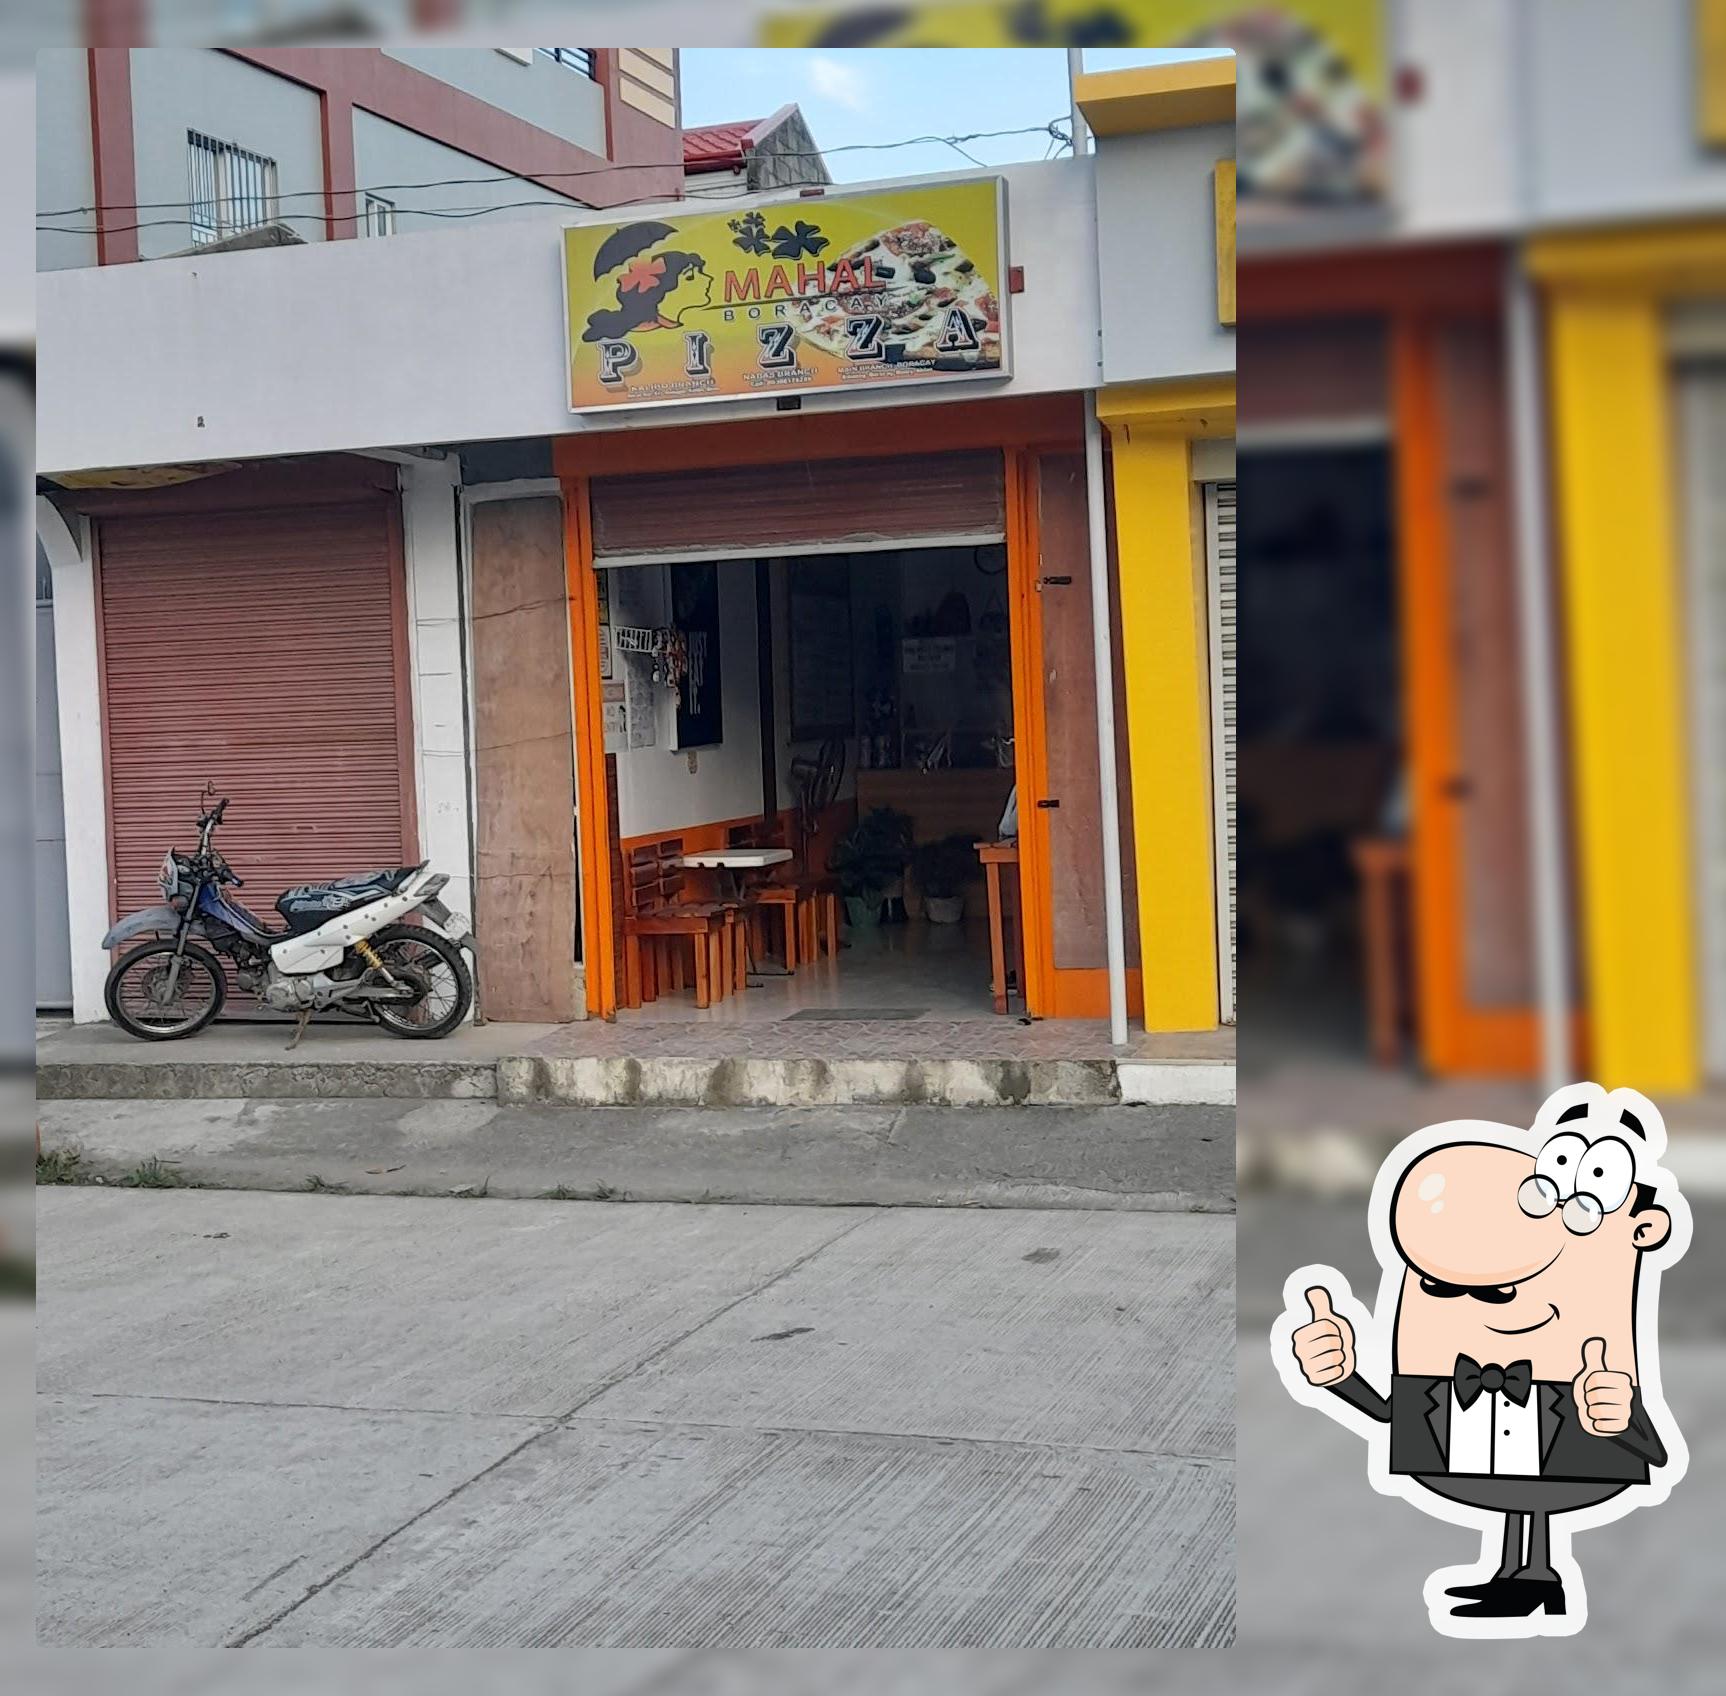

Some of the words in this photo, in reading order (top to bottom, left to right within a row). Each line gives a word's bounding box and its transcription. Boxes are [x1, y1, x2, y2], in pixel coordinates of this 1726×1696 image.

[724, 256, 887, 303] MAHAL
[724, 295, 888, 321] BORACAY
[599, 307, 980, 384] PIZZA
